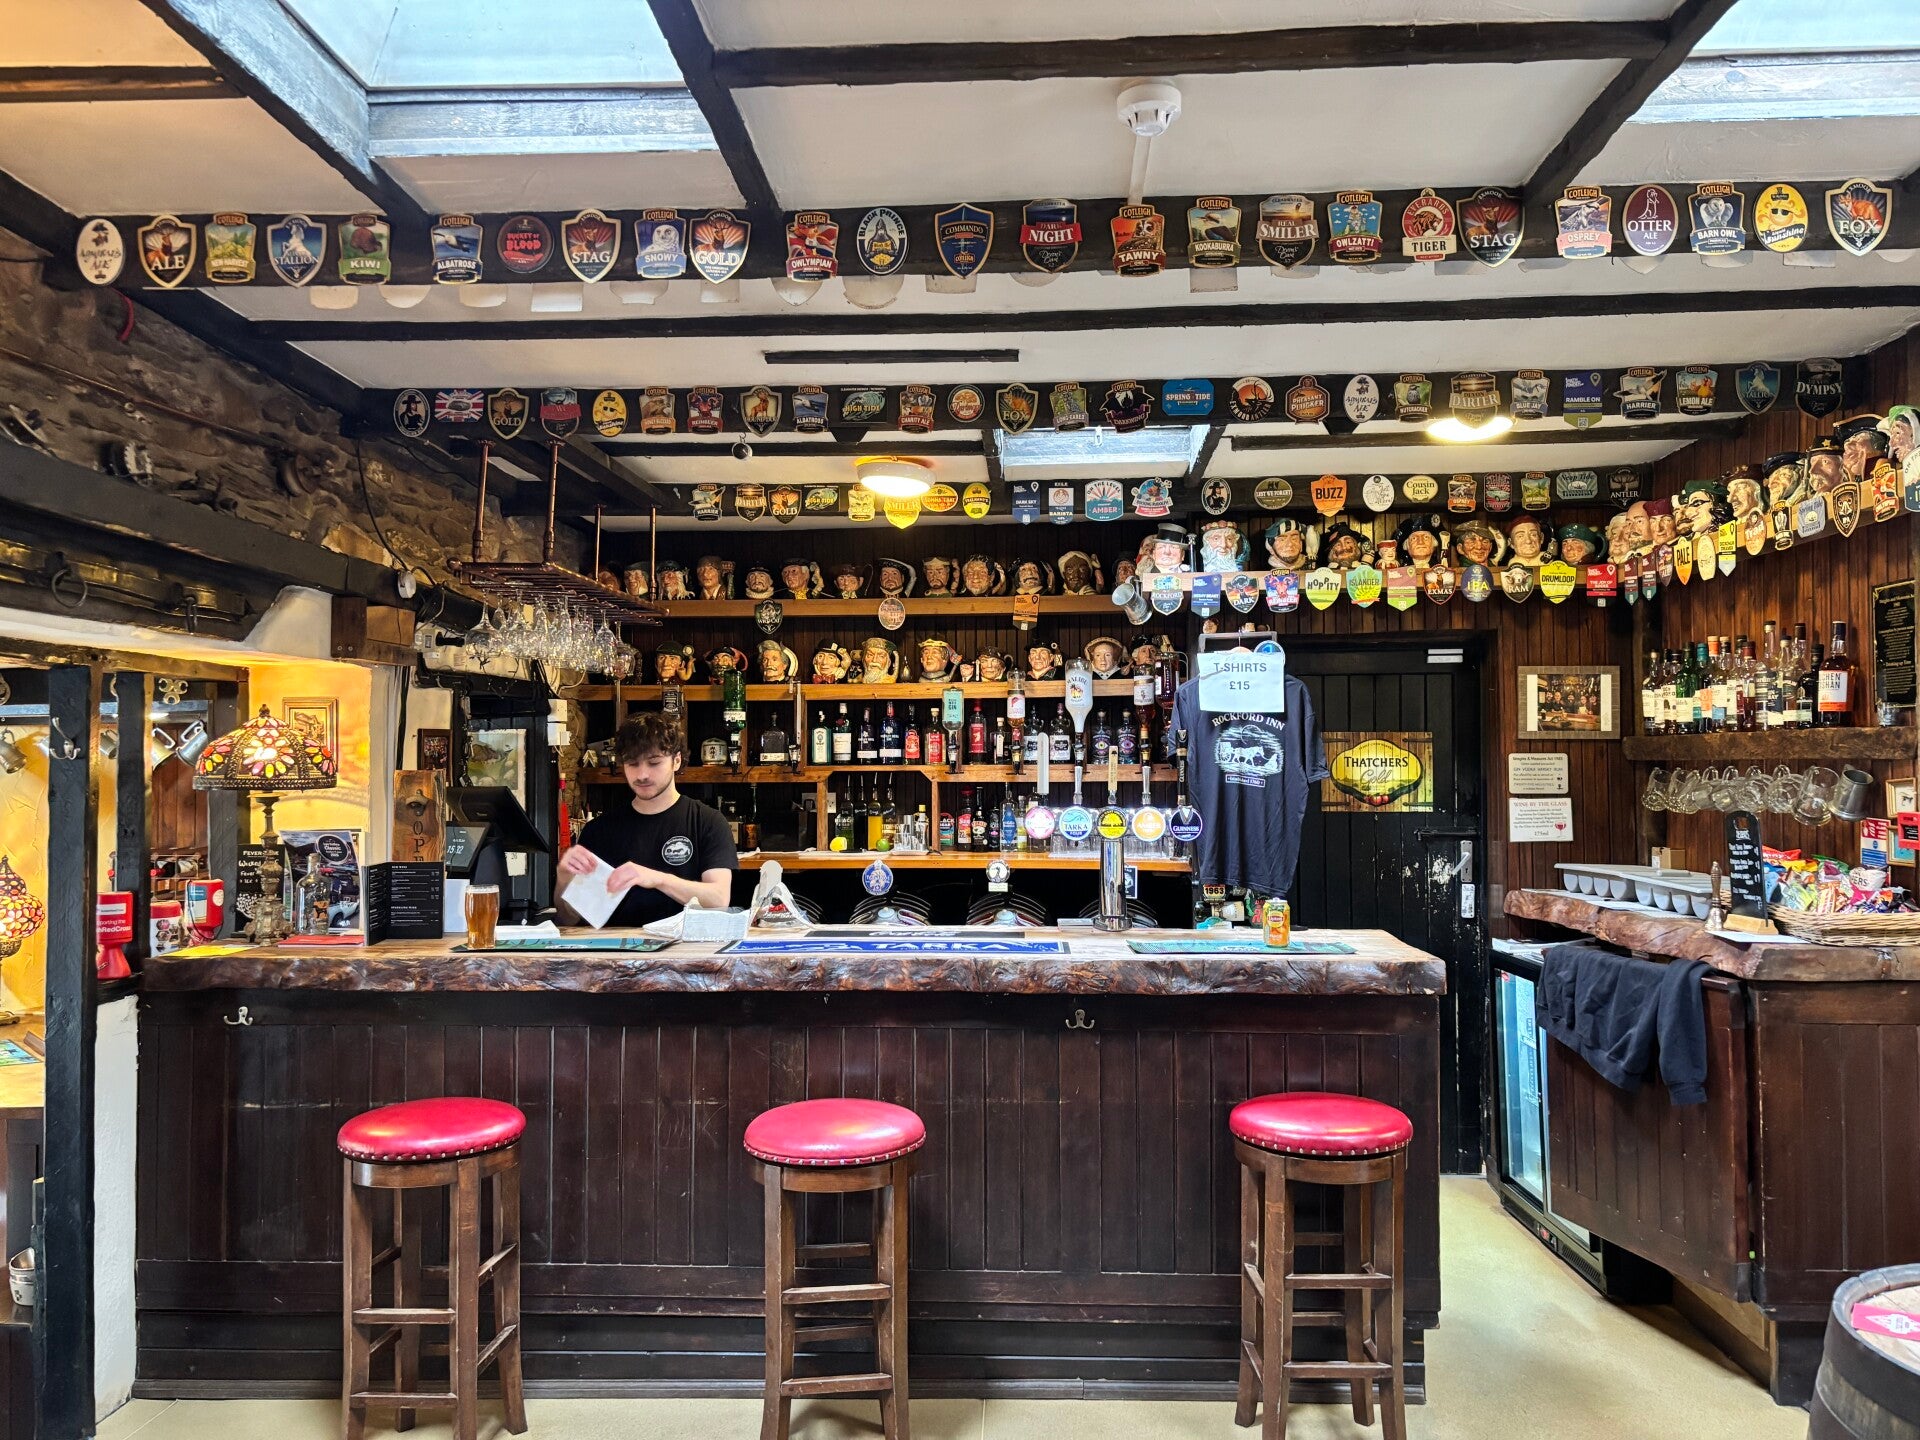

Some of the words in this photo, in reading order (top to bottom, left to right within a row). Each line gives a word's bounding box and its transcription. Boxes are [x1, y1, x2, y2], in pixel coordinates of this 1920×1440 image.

[1569, 189, 1598, 199] COTLEIGH
[1701, 186, 1731, 195] COTLEIGH
[1341, 194, 1369, 204] COTLEIGH
[1200, 200, 1229, 209] COTLEIGH
[1406, 197, 1448, 215] EVERARDS
[647, 210, 674, 220] COTLEIGH
[1123, 208, 1151, 218] COTLEIGH
[799, 215, 826, 224] COTLEIGH
[858, 210, 878, 238] BLACK
[879, 209, 905, 238] PRINCE
[1278, 219, 1296, 227] REAL
[945, 225, 984, 235] COMMANDO
[1259, 223, 1317, 239] SMILER
[1628, 220, 1672, 232] OTTER
[1839, 218, 1879, 234] FOX
[1028, 228, 1074, 243] NIGHT
[1568, 232, 1601, 243] OSPREY
[1643, 232, 1658, 240] ALE
[1698, 230, 1720, 239] BARN
[1721, 229, 1738, 239] OWL
[506, 240, 542, 251] BLOOD
[1470, 233, 1517, 249] STAG
[1195, 243, 1234, 252] KOOKABURRA
[1411, 240, 1447, 253] TIGER
[274, 256, 319, 266] STALLION
[572, 251, 611, 264] STAG
[645, 253, 679, 263] SNOWY
[695, 251, 740, 267] GOLD
[1119, 252, 1159, 263] TAWNY
[150, 255, 186, 271] ALE
[350, 260, 381, 270] KIWI
[437, 259, 476, 270] ALBATROSS
[791, 257, 832, 269] OWLYMPIAN
[1796, 381, 1844, 395] DYMPSY
[1292, 394, 1323, 404] PHEASANT
[1452, 395, 1500, 408] DARTER
[1680, 397, 1700, 406] LEMON
[1701, 397, 1713, 406] ALE
[844, 404, 862, 413] HIGH
[864, 404, 880, 412] TIDE
[1626, 402, 1656, 410] HARRIER
[1003, 410, 1029, 422] FOX
[492, 417, 522, 427] GOLD
[1315, 487, 1344, 500] BUZZ
[1412, 487, 1430, 496] Jack
[1611, 491, 1639, 499] ANTLER
[772, 507, 797, 516] GOLD
[1676, 547, 1690, 567] PALE
[1307, 577, 1340, 591] HOPPITY
[1350, 578, 1380, 587] ISLANDER
[1541, 575, 1575, 583] DRUMLOOP
[1467, 581, 1489, 592] IPA
[1508, 584, 1530, 594] RAM
[1428, 588, 1453, 596] EXMAS
[1233, 597, 1255, 606] DARK
[1213, 662, 1267, 673] T-SHIRTS
[1066, 674, 1088, 686] MALIBU
[1229, 681, 1250, 690] £15
[1211, 712, 1264, 728] ROCKFORD
[1265, 716, 1286, 731] INN
[1344, 756, 1409, 768] THATCHERS
[1360, 769, 1393, 785] Gold
[1204, 887, 1225, 895] 1963
